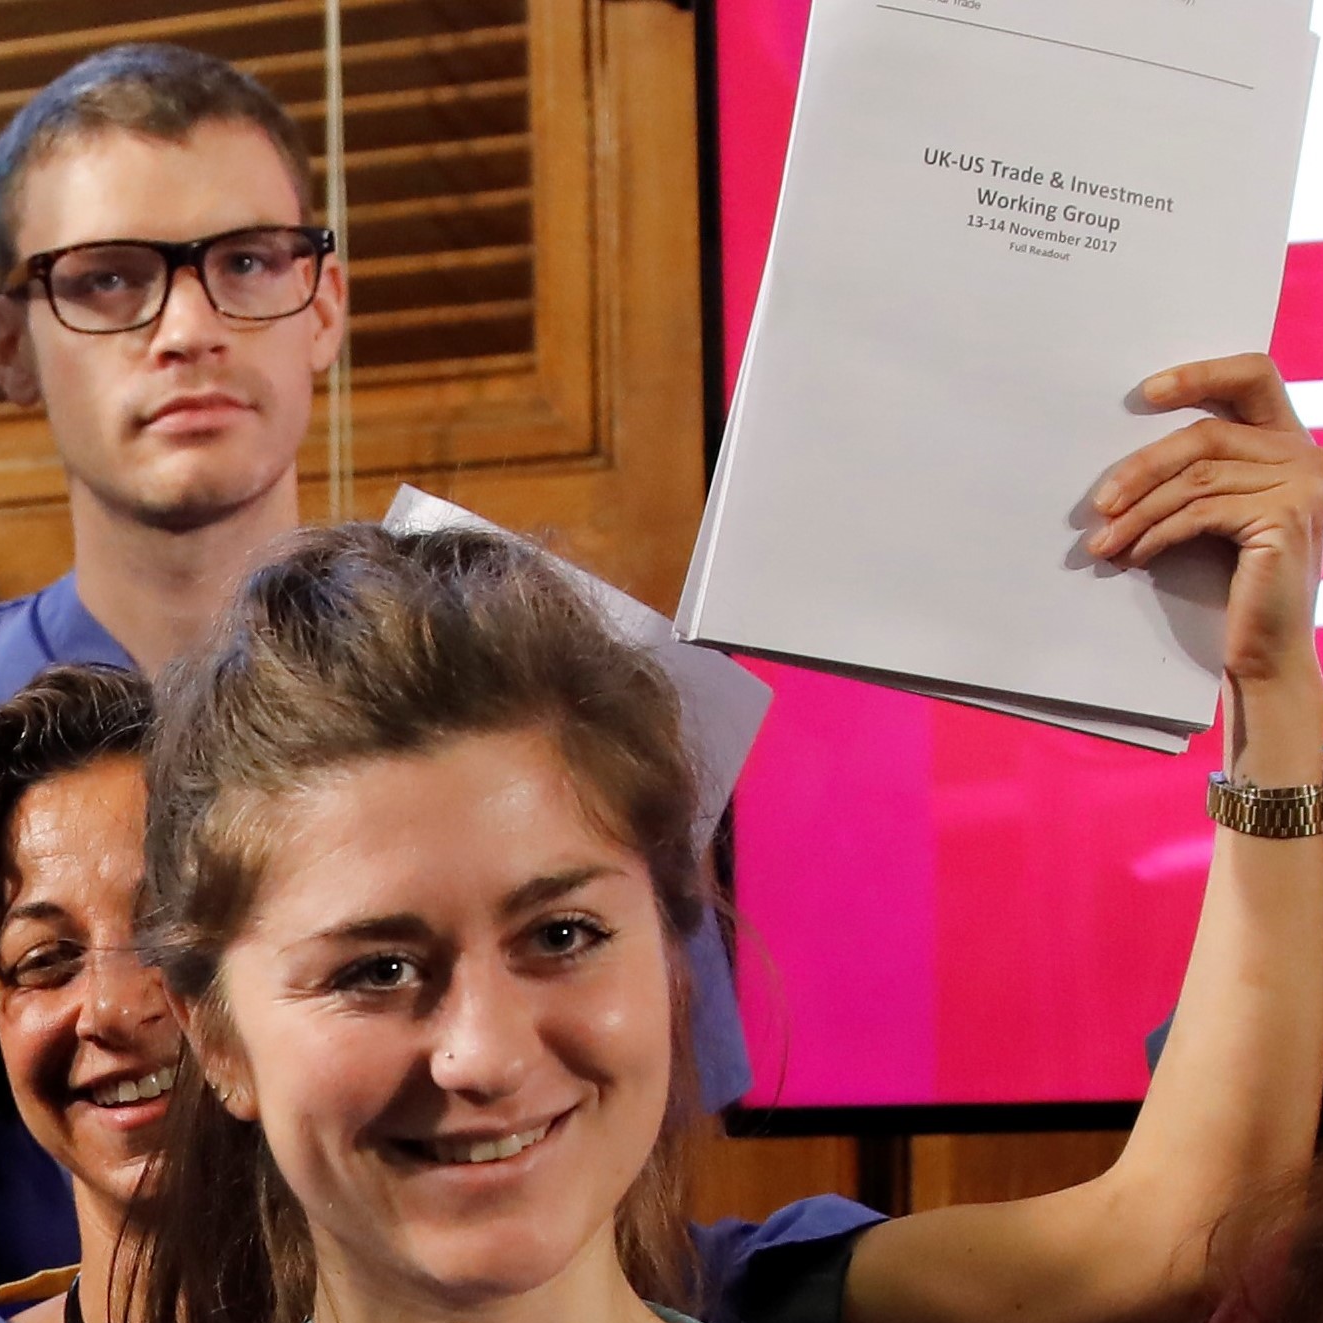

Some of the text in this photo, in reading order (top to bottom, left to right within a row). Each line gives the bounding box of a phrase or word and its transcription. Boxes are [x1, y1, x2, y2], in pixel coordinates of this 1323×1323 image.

[924, 148, 1173, 212] UK-US Trade & Investment
[978, 188, 1120, 233] Working Group
[967, 215, 1117, 253] 13-14 November 2017
[1009, 242, 1070, 261] Full Readout
